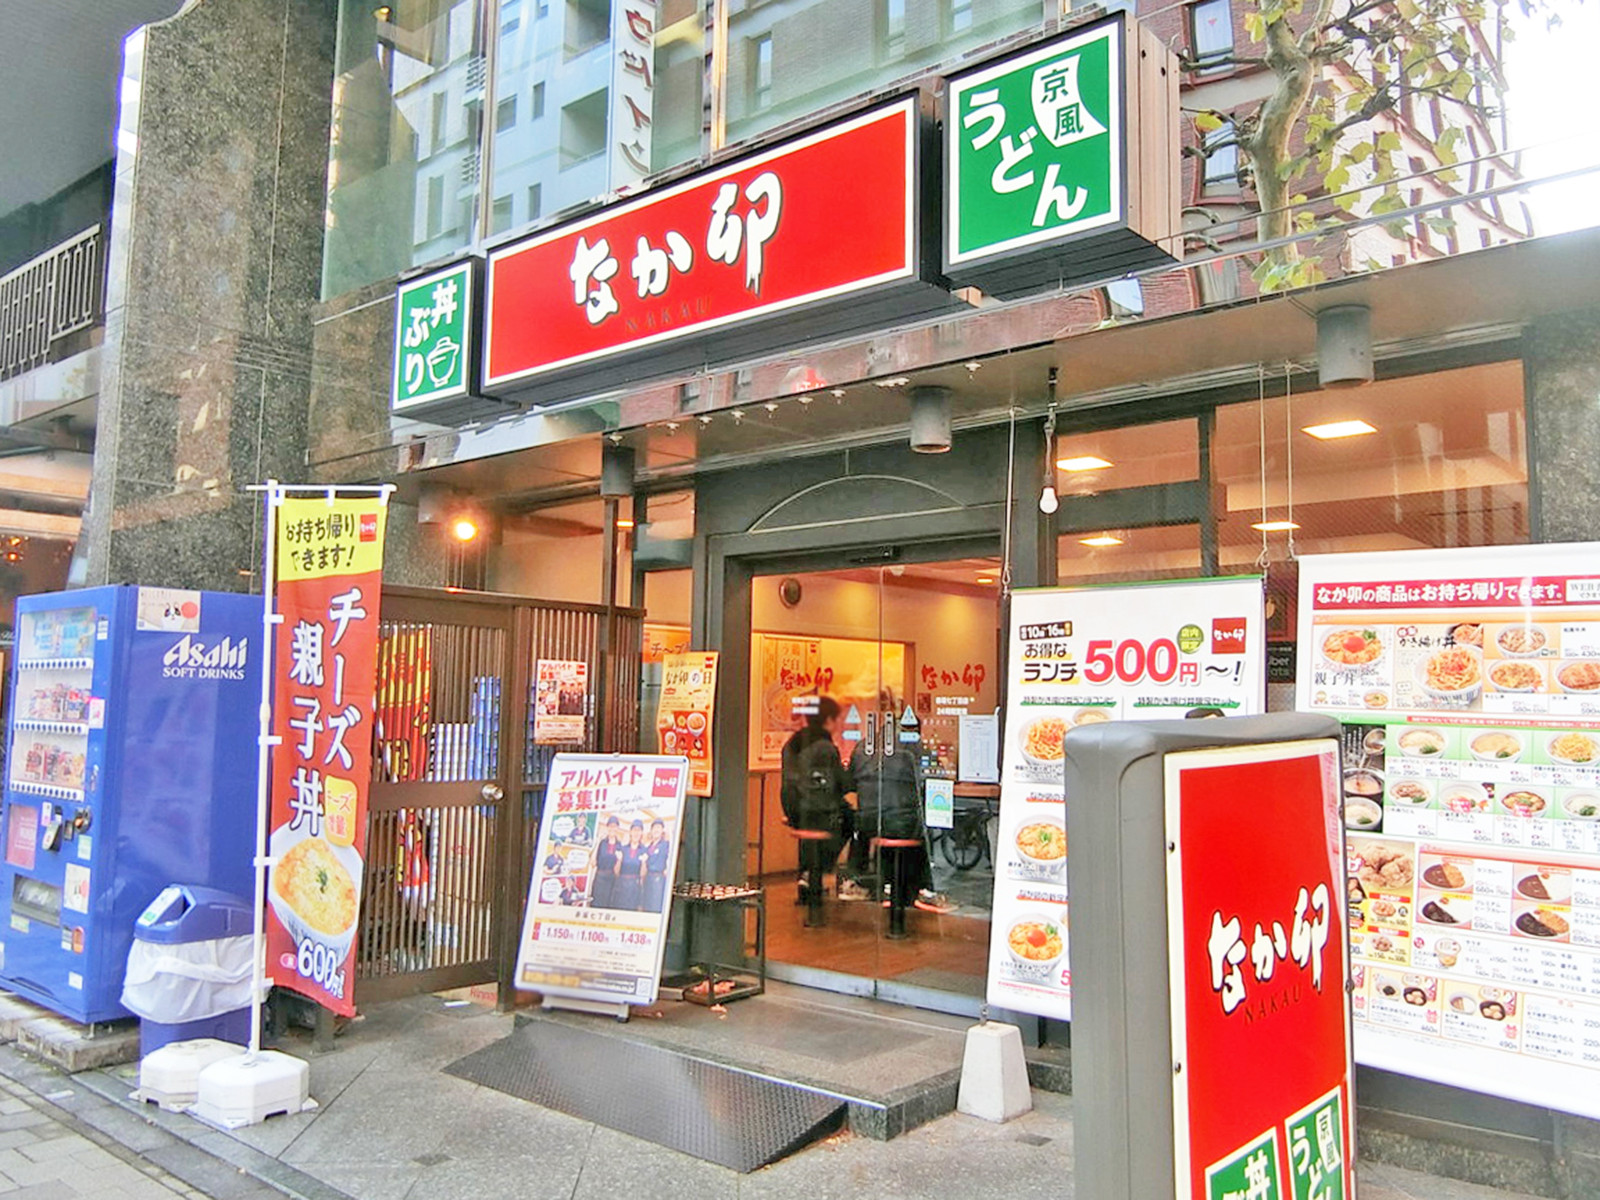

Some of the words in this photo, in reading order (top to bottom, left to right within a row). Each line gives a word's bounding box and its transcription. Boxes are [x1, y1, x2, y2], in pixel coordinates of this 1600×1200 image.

[1038, 67, 1085, 141] 京風
[963, 88, 1088, 228] うどん
[570, 171, 782, 326] なか卯
[626, 298, 710, 332] NAKAU
[403, 279, 458, 396] 丼ぶり
[286, 513, 355, 545] お持ち帰り
[1316, 581, 1563, 605] なか卯の商品はお持ち帰りできます。
[1214, 628, 1245, 642] なか卯
[163, 635, 247, 669] Asahi
[1024, 642, 1068, 659] お得な
[163, 668, 198, 678] SOFT
[199, 668, 245, 680] DRINKS
[324, 588, 368, 770] チーズ
[780, 666, 833, 692] なか卯
[921, 664, 985, 692] なか卯
[1024, 662, 1078, 682] ランチ
[1314, 671, 1355, 686] 親子丼
[288, 619, 326, 836] 親子丼
[561, 765, 643, 789] アルバイト
[655, 776, 677, 788] なか卯
[557, 788, 607, 812] 募集!!
[1207, 882, 1330, 1016] なか卯
[1243, 984, 1301, 1025] NAKAU
